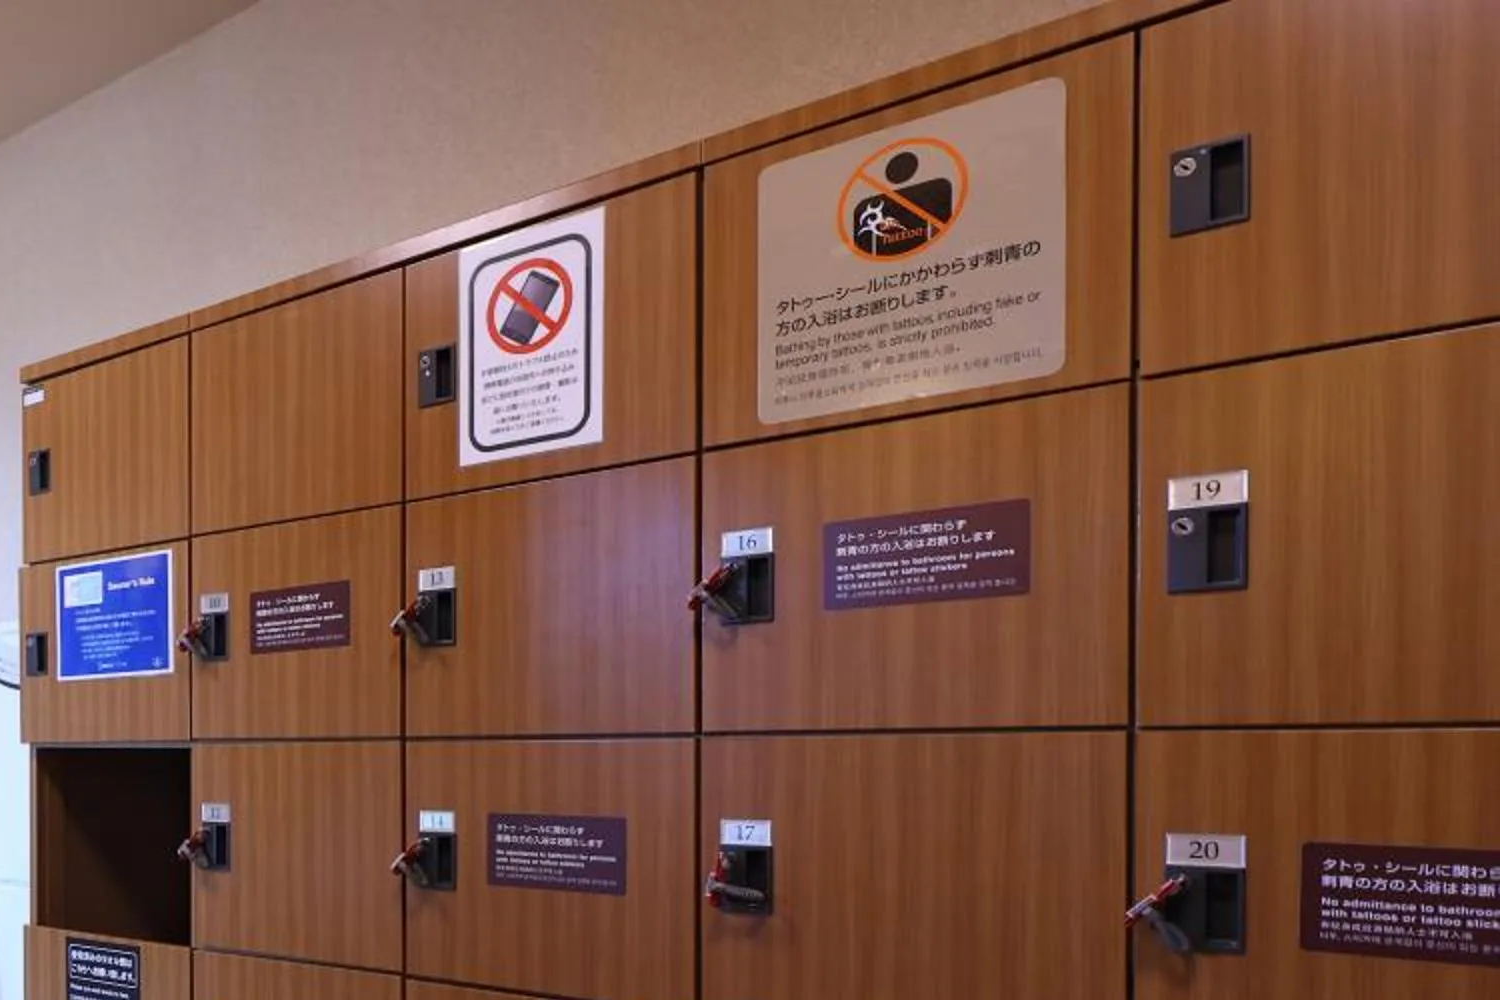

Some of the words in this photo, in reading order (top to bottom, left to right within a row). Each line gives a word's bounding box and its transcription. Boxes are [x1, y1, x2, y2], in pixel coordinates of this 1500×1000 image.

[834, 330, 865, 344] those
[1193, 478, 1221, 500] 19
[738, 534, 757, 551] 16
[737, 825, 756, 841] 17
[1188, 840, 1220, 861] 20
[1320, 874, 1500, 898] 刺青の方の入浴はお断
[1321, 896, 1339, 907] No
[1343, 898, 1417, 913] admittance
[1421, 903, 1435, 914] to
[1321, 909, 1348, 918] with
[1351, 911, 1399, 922] tattoos
[1403, 915, 1416, 923] or
[1421, 915, 1461, 927] tattoo
